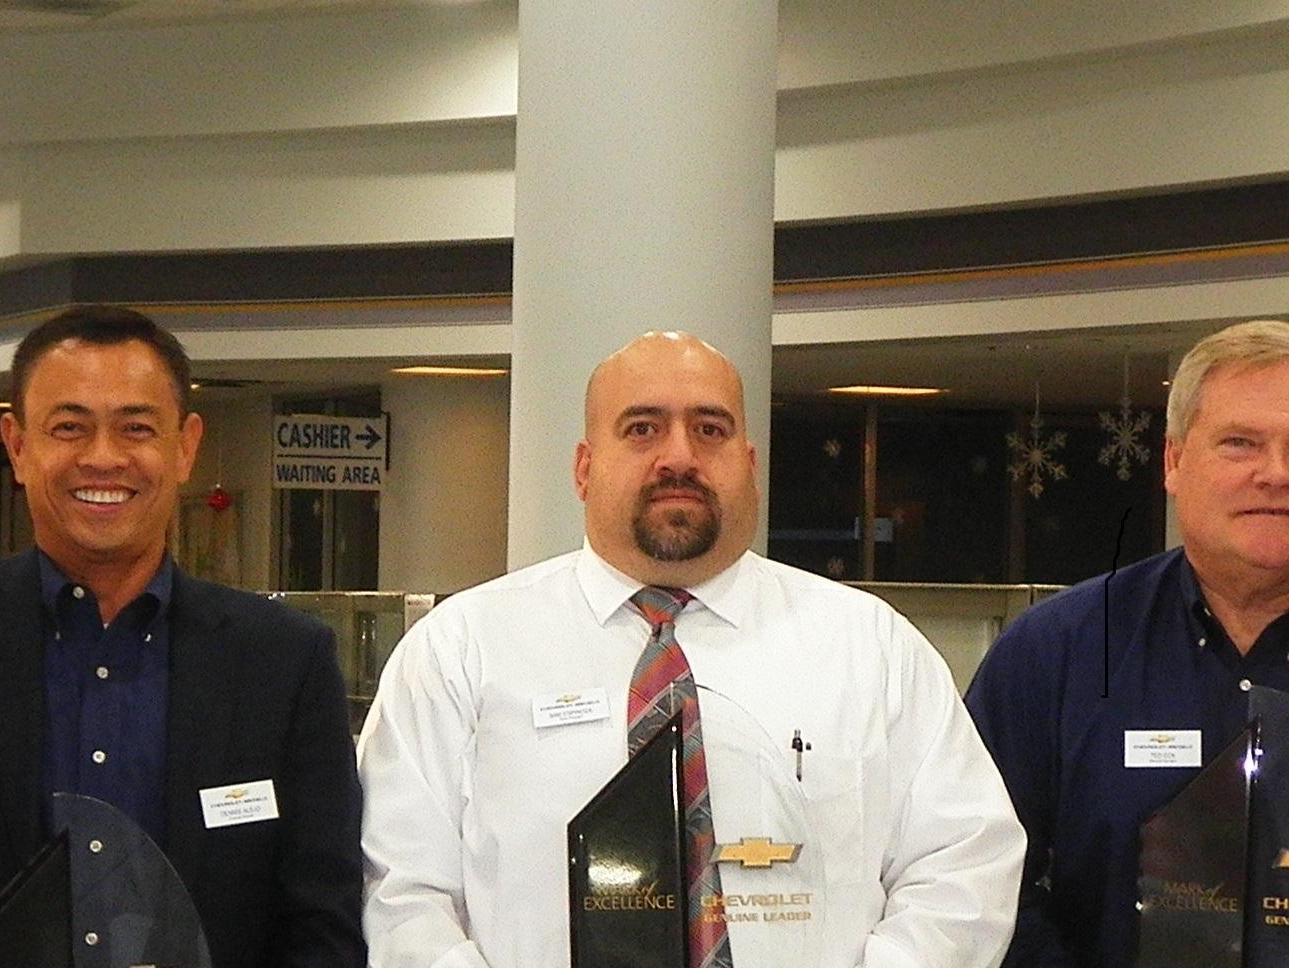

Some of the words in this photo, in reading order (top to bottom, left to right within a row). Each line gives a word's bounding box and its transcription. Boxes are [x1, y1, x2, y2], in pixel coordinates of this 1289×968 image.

[277, 422, 351, 449] CASHIER
[276, 464, 336, 483] WAITING
[341, 465, 382, 485] AREA
[583, 894, 676, 911] EXCELLENCE
[700, 892, 814, 907] CHEVROLET
[703, 912, 759, 923] GENUINE
[763, 911, 812, 922] LEADER
